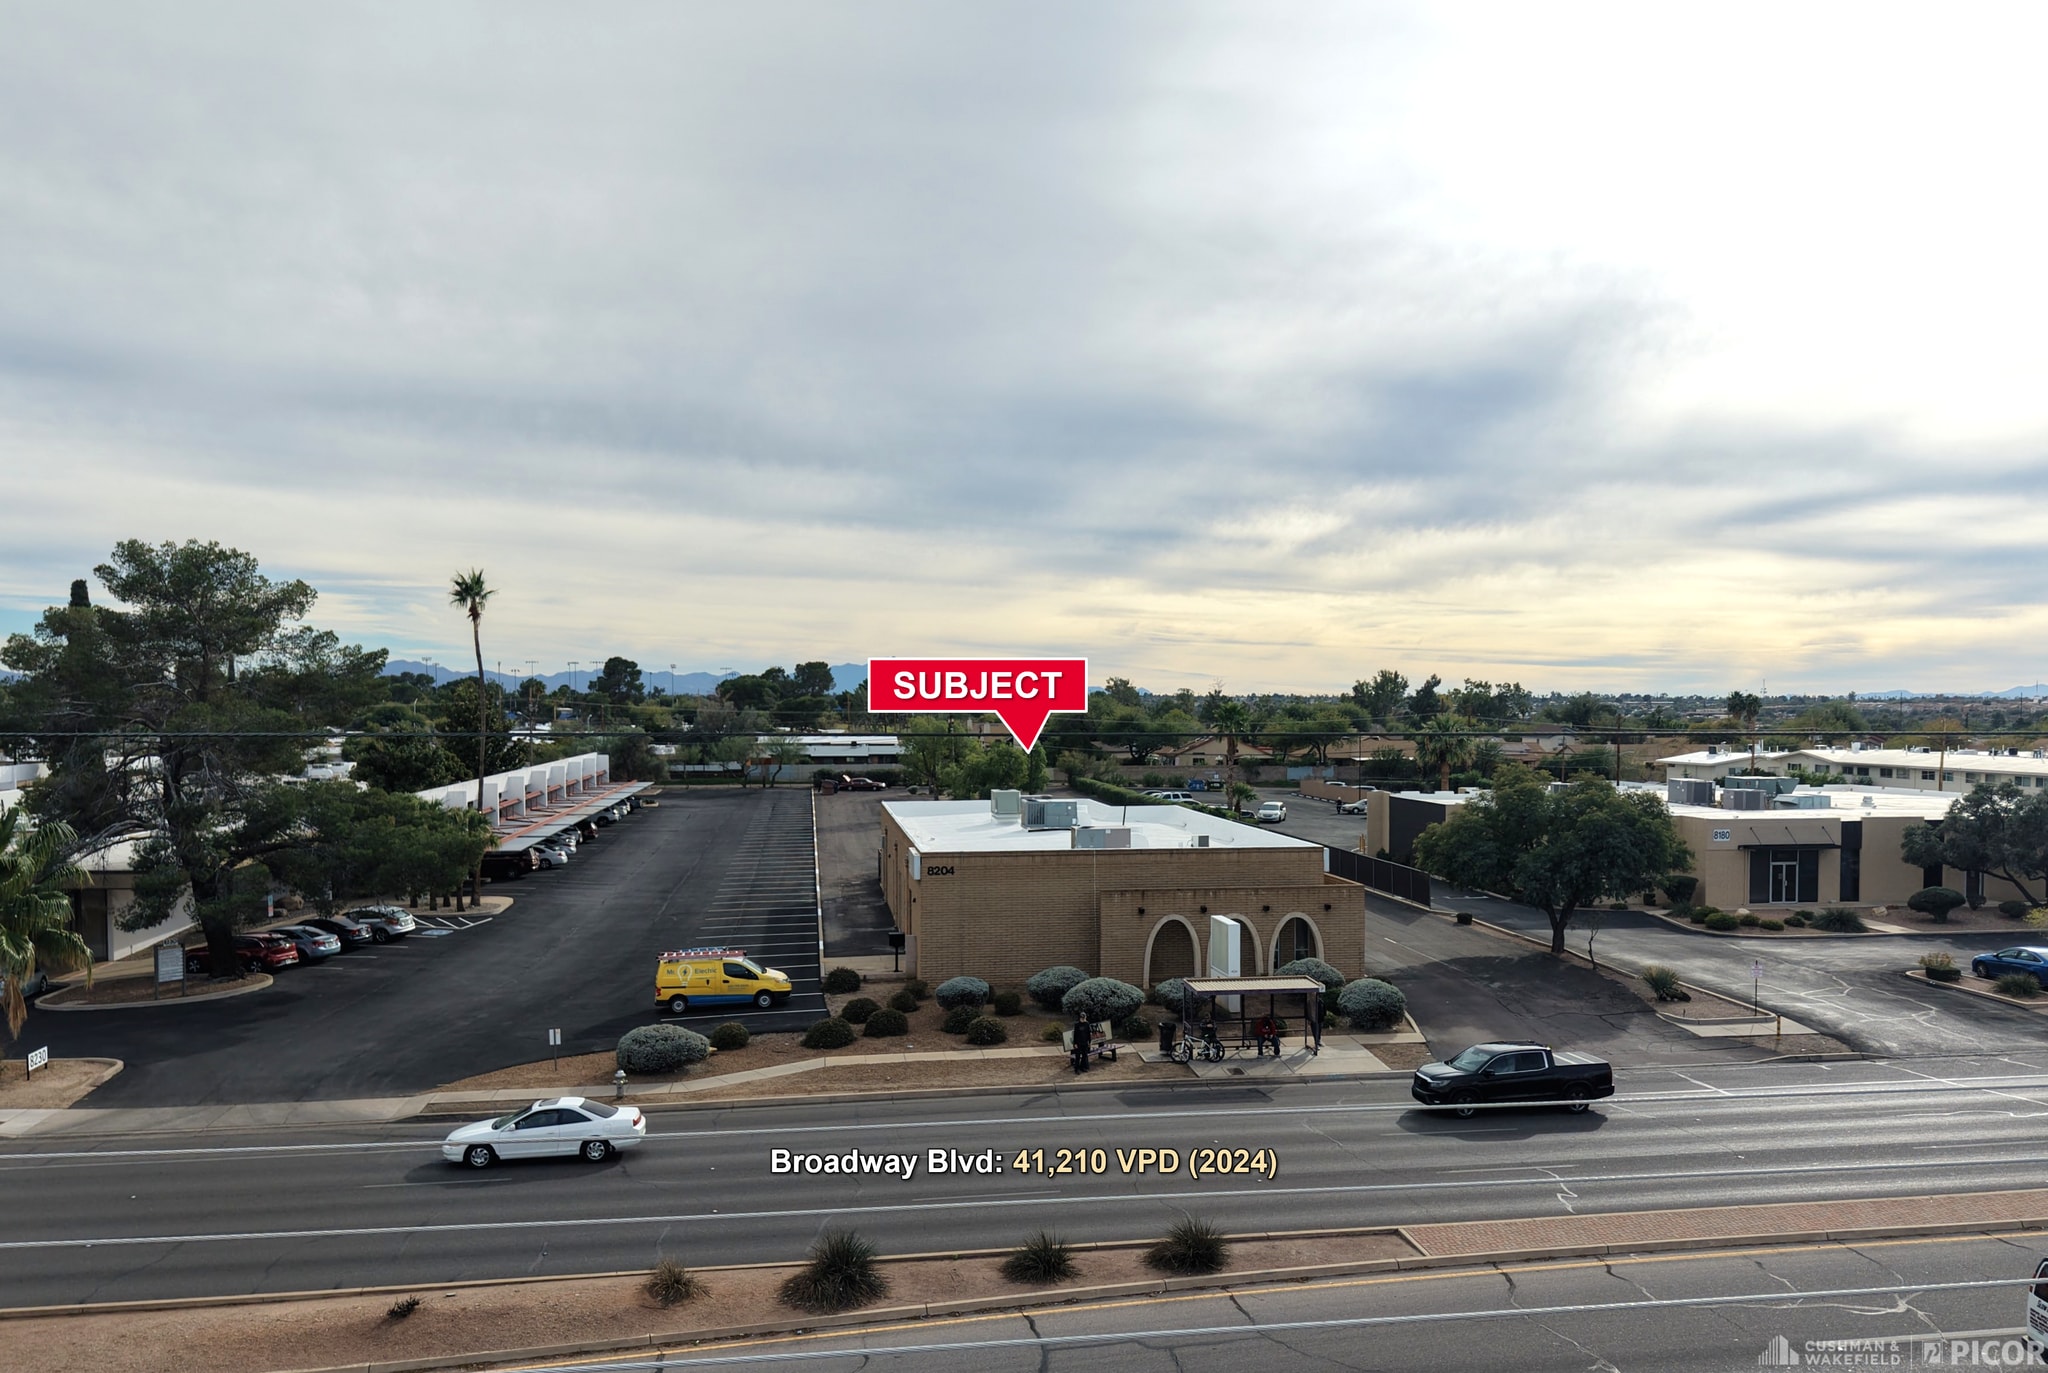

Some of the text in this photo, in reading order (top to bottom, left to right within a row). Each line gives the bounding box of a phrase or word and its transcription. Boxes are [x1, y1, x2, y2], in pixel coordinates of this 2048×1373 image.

[1713, 831, 1730, 839] 8180
[927, 866, 955, 876] 8204
[30, 1049, 46, 1067] 8230
